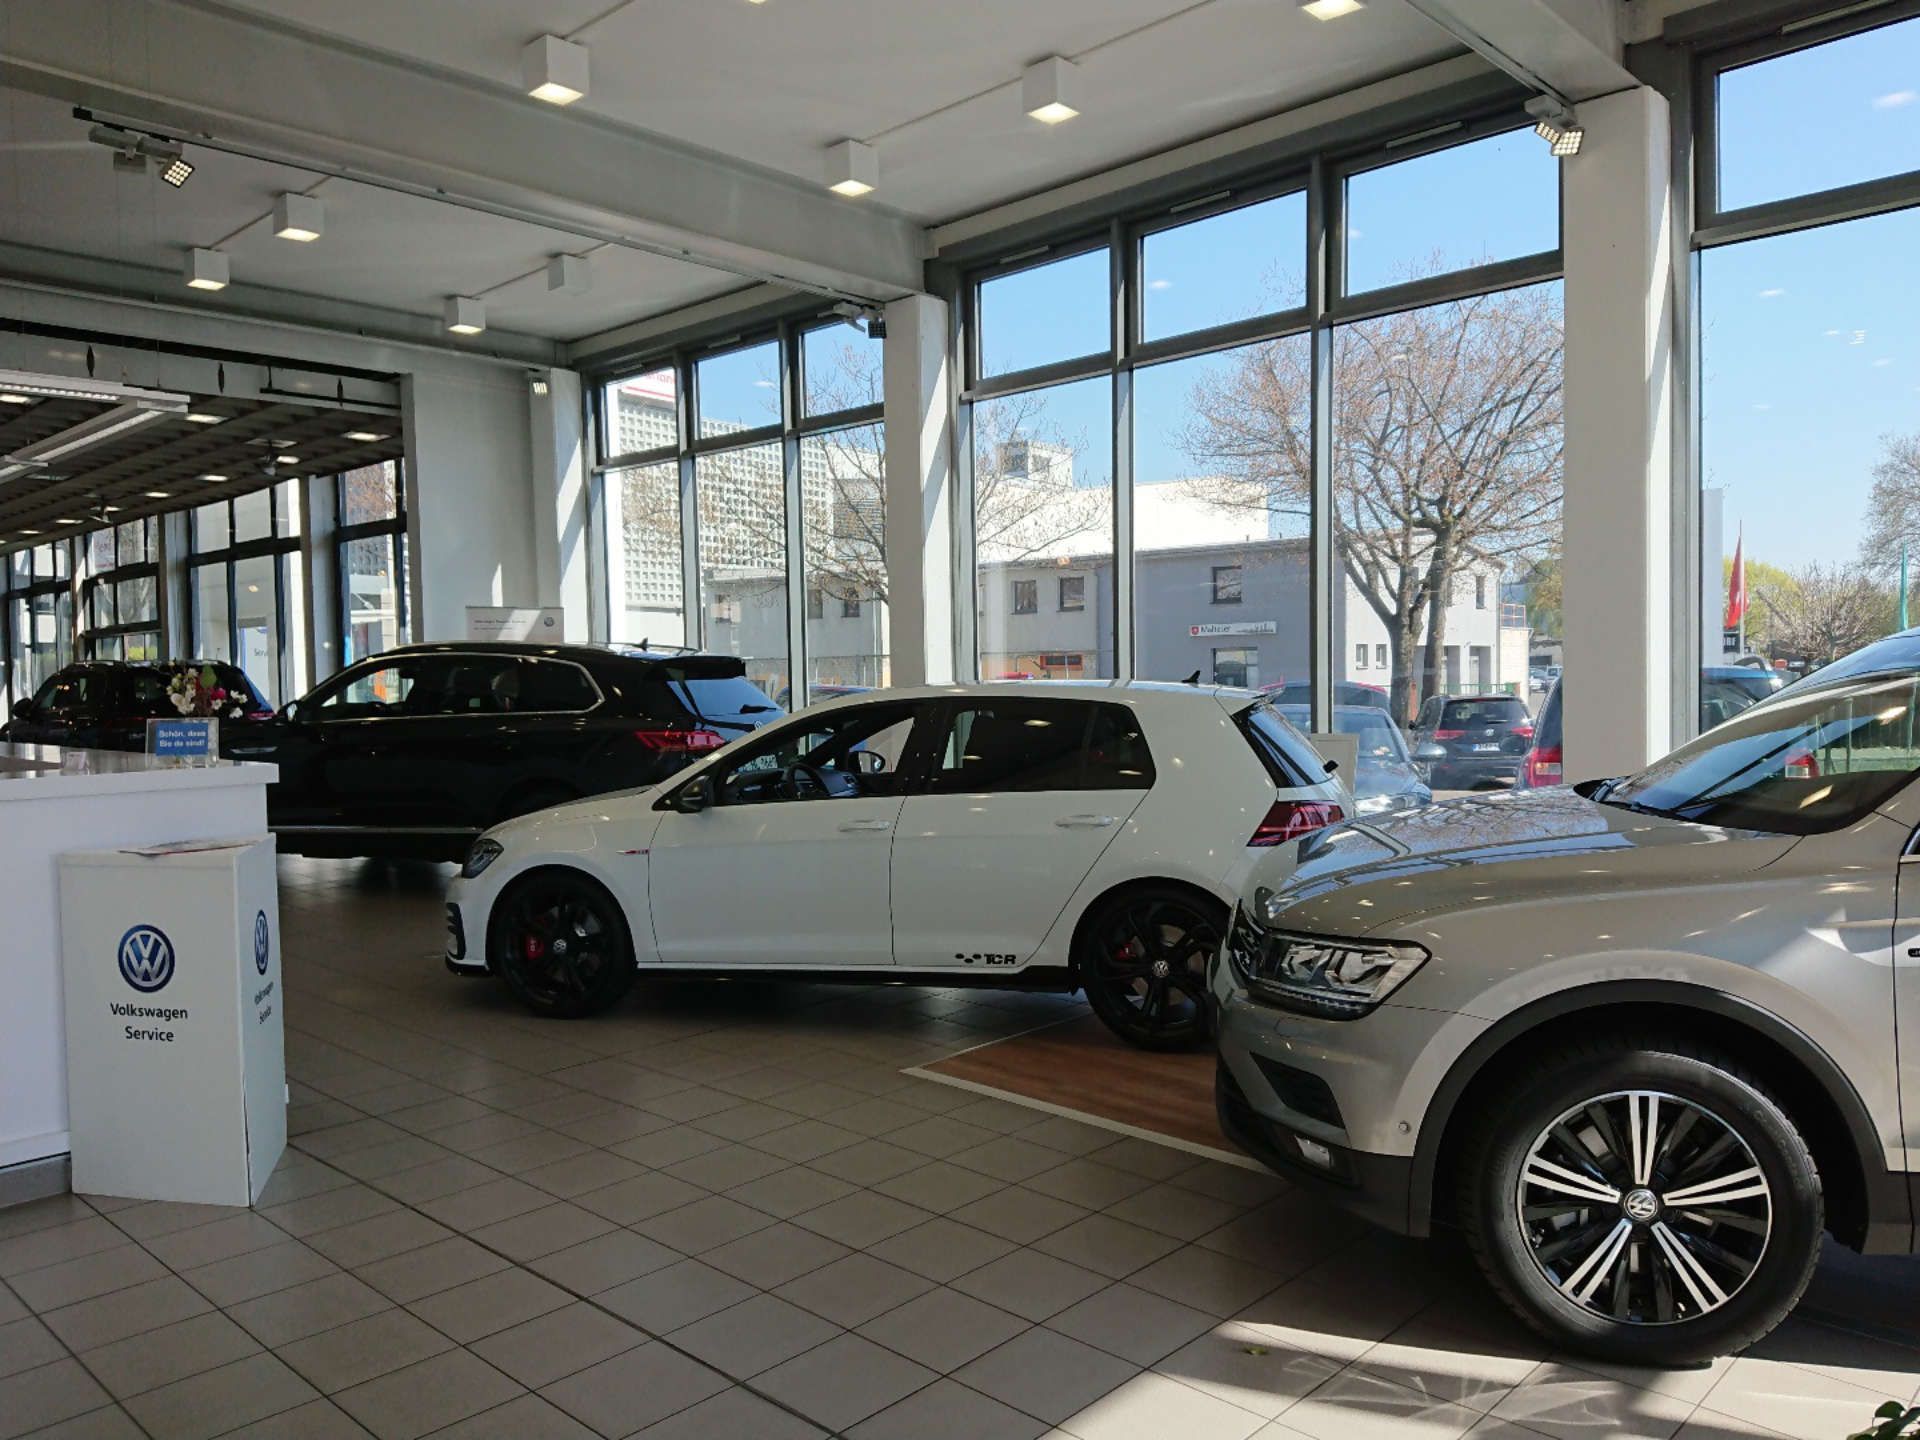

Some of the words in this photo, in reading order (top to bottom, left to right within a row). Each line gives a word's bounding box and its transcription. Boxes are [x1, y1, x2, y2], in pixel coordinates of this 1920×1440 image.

[983, 953, 1017, 965] TCR
[110, 1002, 188, 1021] Volkswagen
[125, 1026, 174, 1042] Service
